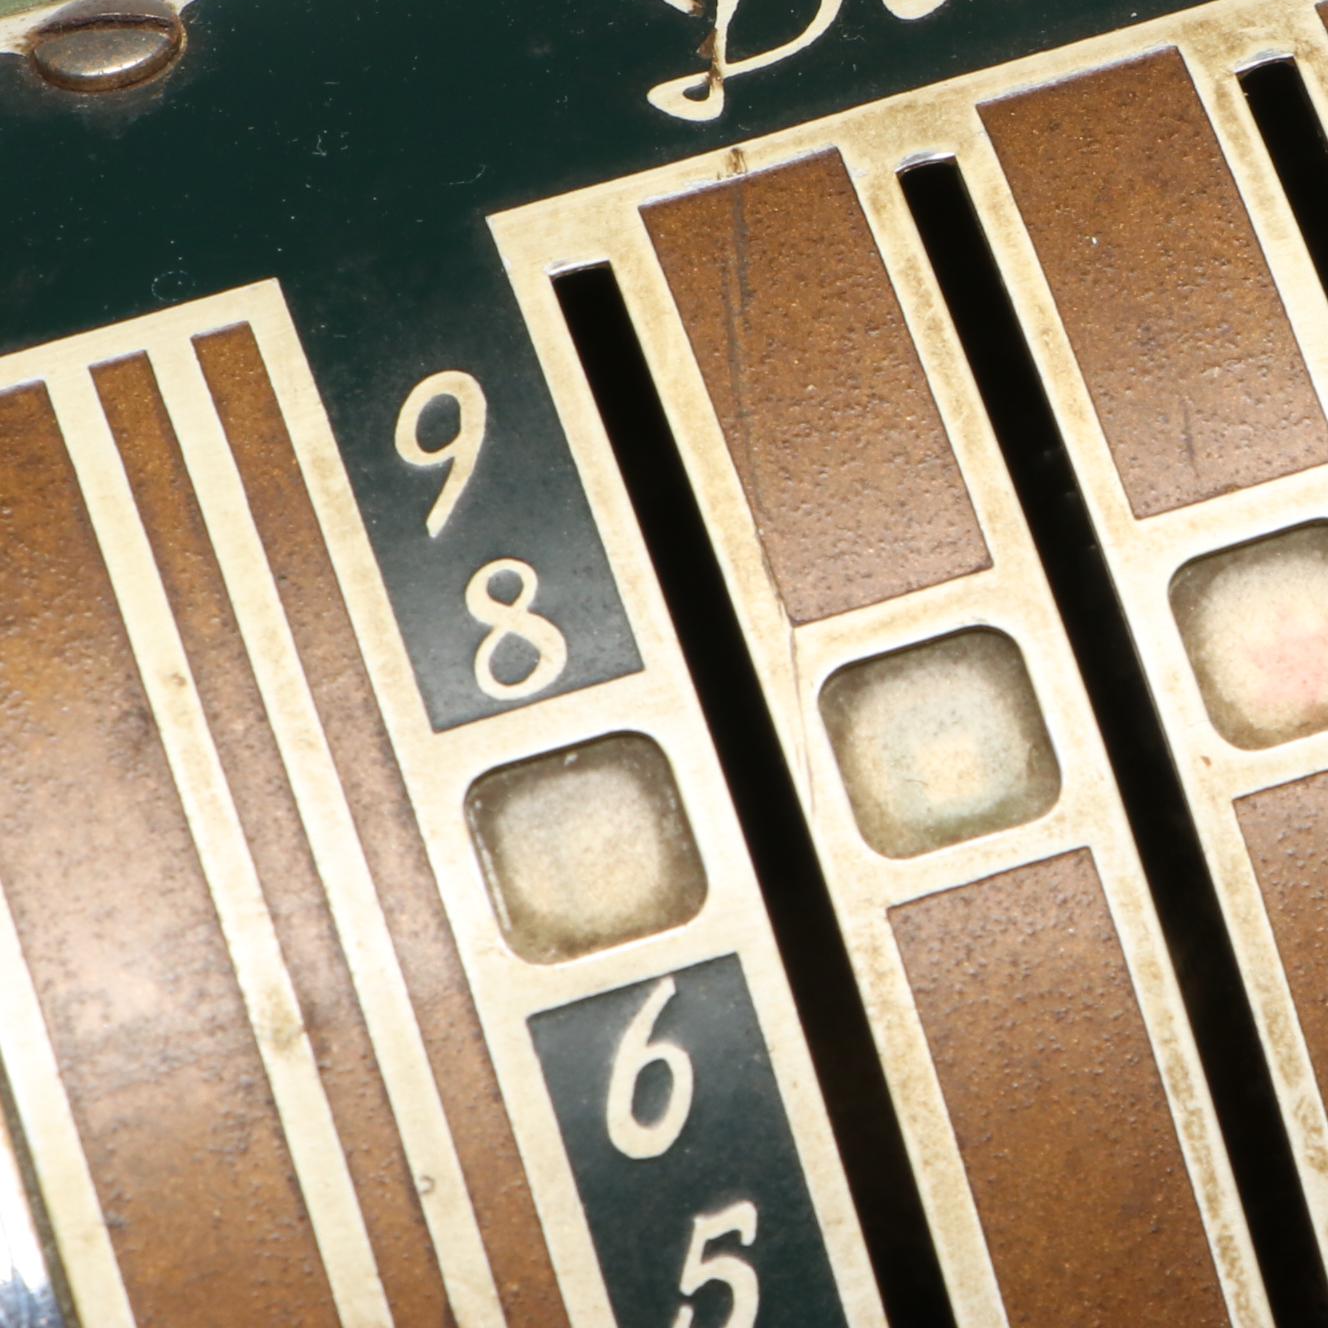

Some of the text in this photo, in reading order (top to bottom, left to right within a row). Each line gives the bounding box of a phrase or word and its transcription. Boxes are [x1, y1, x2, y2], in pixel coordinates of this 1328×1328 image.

[394, 370, 487, 540] 9
[465, 558, 567, 701] 8
[606, 975, 693, 1160] 6
[670, 1200, 760, 1328] 5
